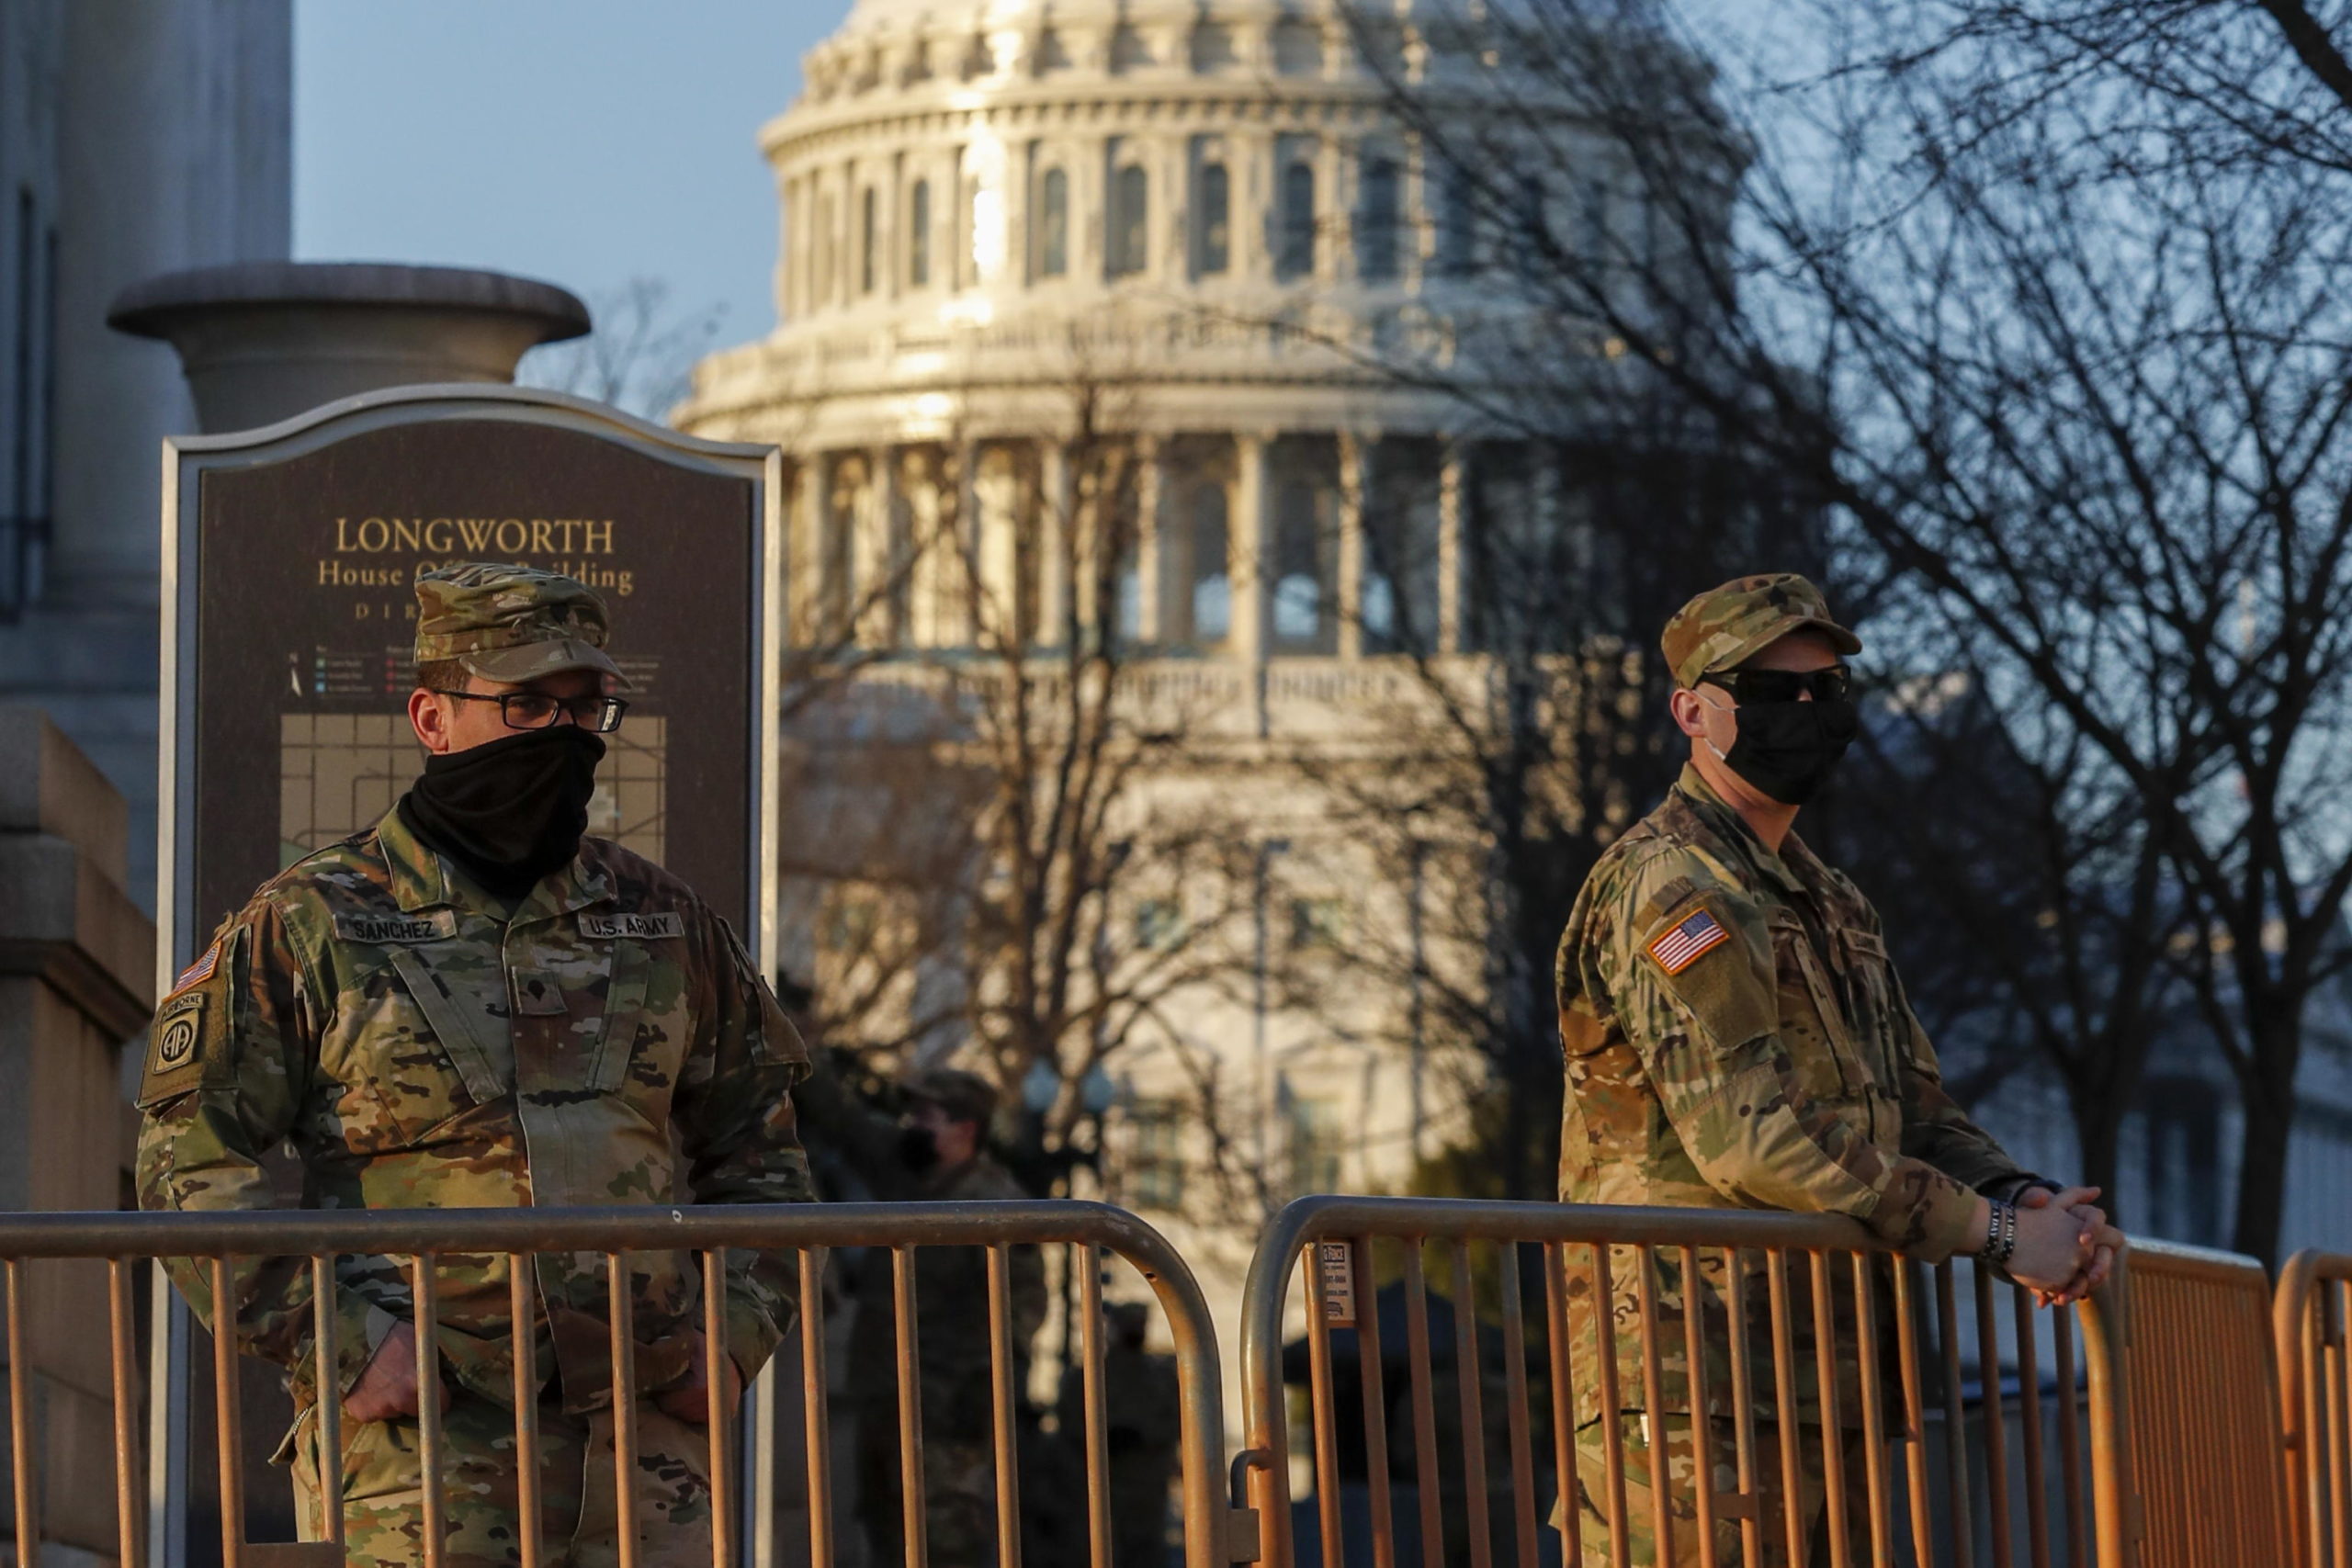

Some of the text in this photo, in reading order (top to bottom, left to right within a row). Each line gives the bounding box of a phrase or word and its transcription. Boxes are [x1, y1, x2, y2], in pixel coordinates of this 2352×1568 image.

[334, 517, 616, 554] LONGWORTH
[318, 560, 404, 586] House
[515, 560, 634, 596] lding
[354, 919, 436, 940] SANCHEZ
[589, 917, 670, 936] U.S. ARMY
